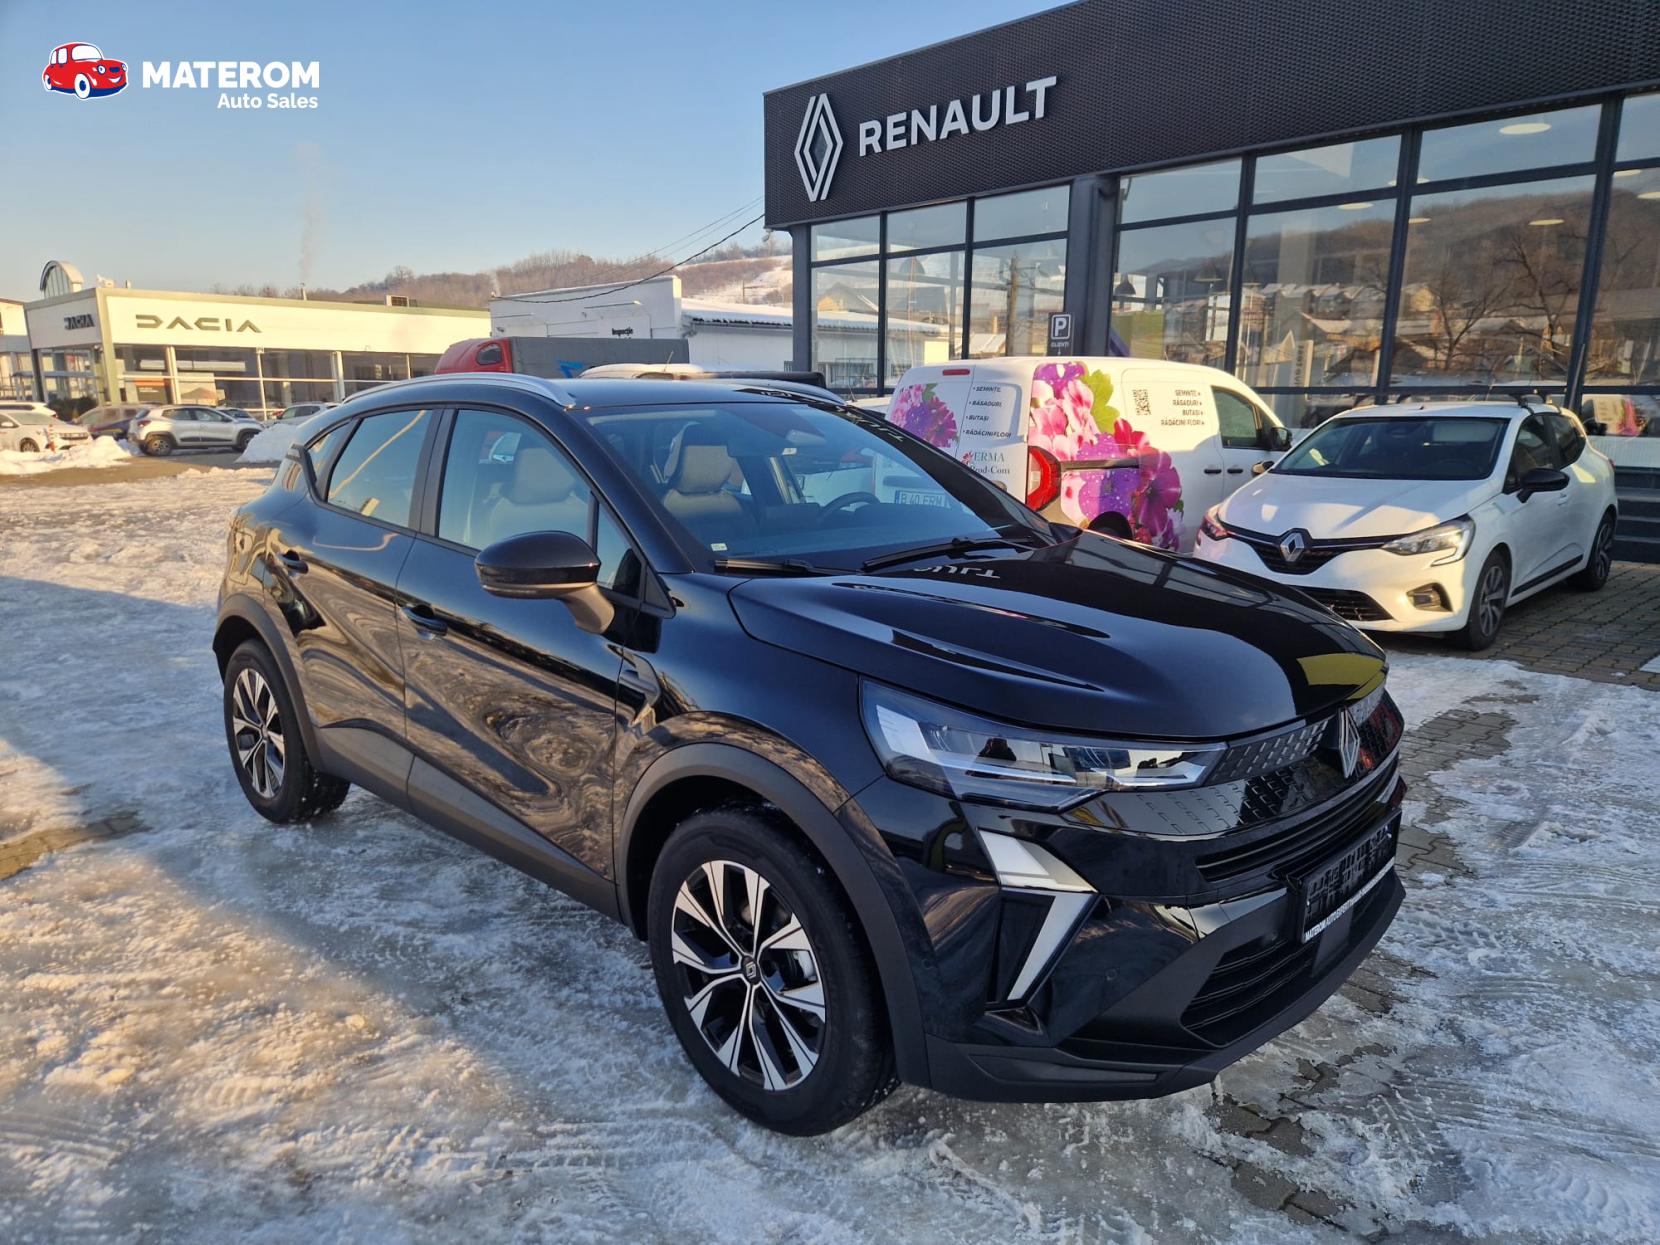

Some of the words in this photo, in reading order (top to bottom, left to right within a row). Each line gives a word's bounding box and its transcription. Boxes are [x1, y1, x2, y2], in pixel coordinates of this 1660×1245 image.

[859, 76, 1057, 157] RENAULT
[64, 313, 95, 330] DACIA
[135, 314, 262, 333] DACIA
[1055, 317, 1067, 337] P
